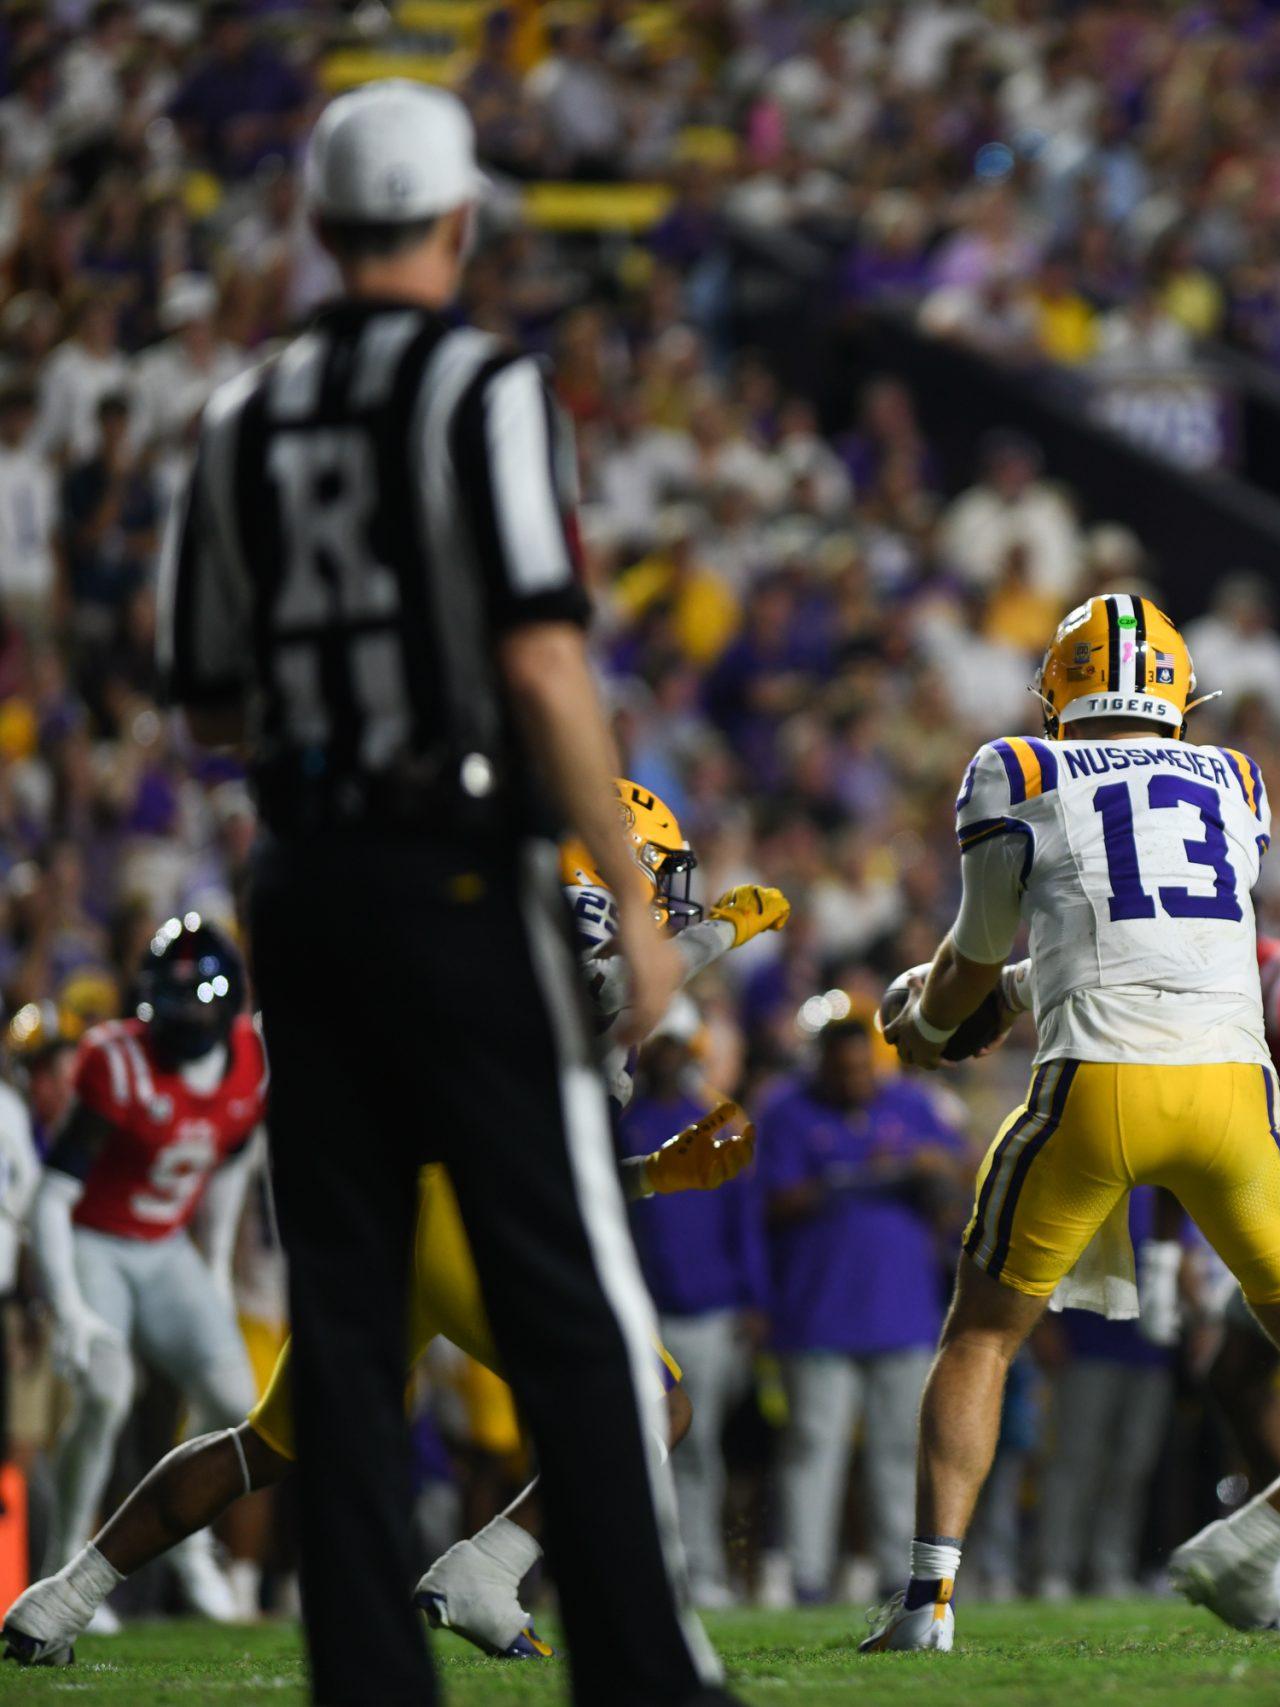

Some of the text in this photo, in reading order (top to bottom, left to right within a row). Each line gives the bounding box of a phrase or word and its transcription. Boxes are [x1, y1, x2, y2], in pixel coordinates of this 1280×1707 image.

[268, 430, 400, 628] R
[1088, 698, 1167, 716] TIGERS
[1063, 746, 1230, 789] NUSSMEIER
[1093, 774, 1244, 923] 13
[130, 1118, 217, 1223] 9
